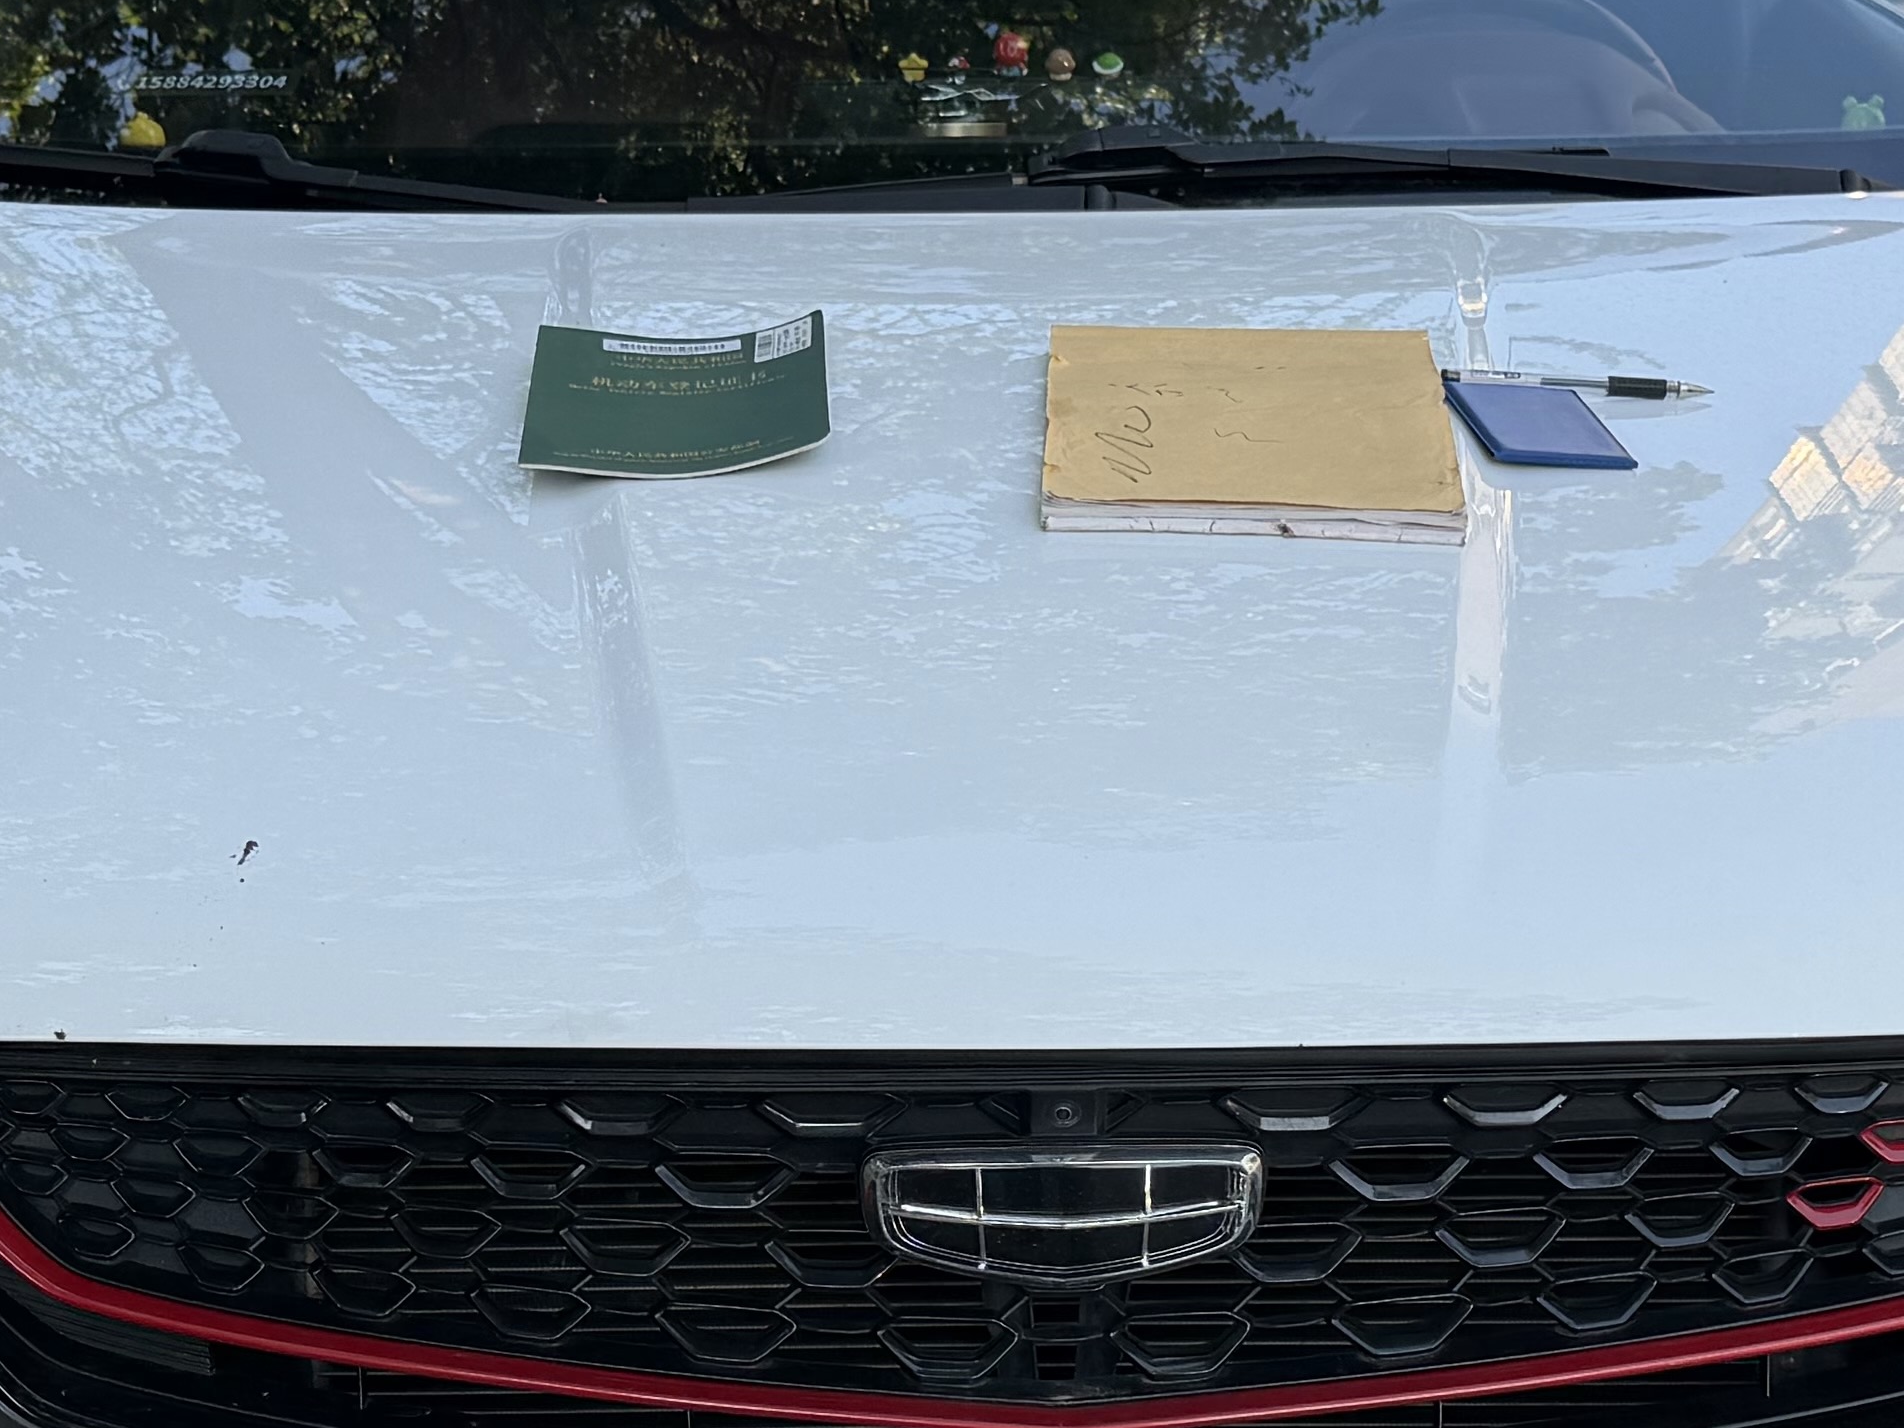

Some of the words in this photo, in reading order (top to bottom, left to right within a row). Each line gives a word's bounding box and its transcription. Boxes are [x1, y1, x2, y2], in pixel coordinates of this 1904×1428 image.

[135, 74, 288, 90] 15884293304
[591, 369, 767, 391] 机动车登记证书
